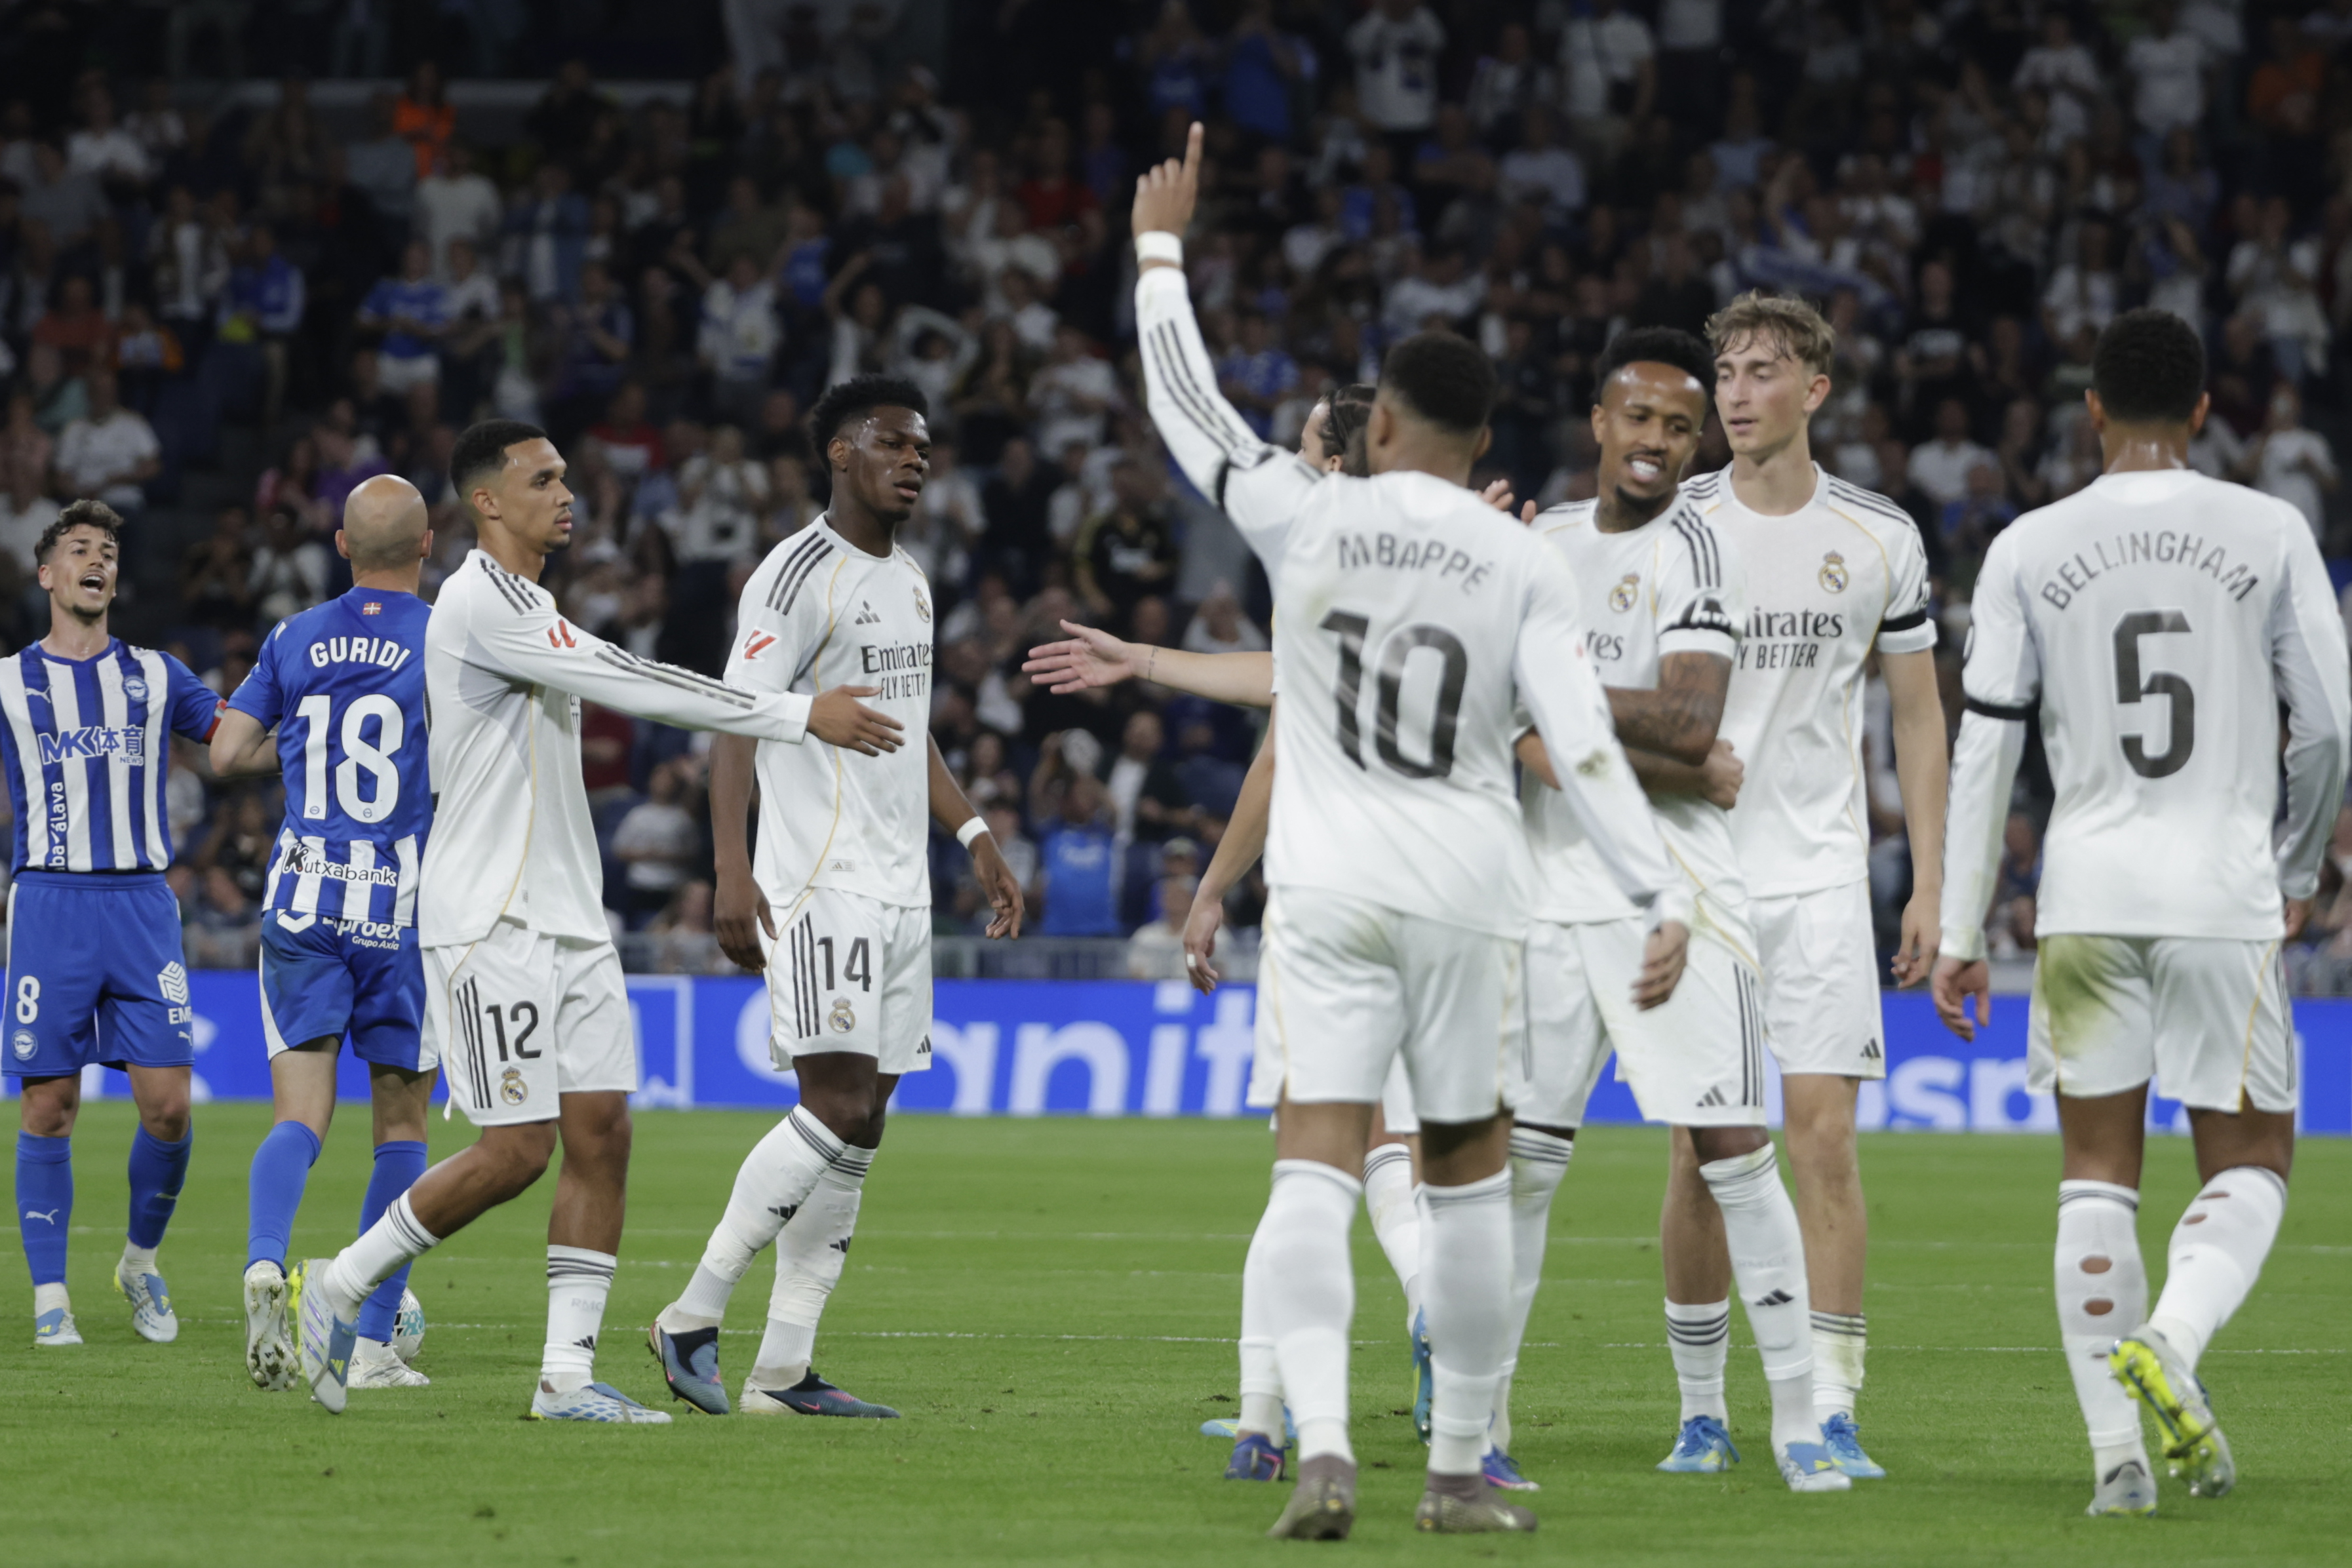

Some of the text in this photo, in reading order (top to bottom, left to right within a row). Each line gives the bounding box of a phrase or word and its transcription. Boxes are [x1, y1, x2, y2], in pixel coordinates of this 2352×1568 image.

[1337, 532, 1495, 596] MBAPPÉ
[2040, 530, 2259, 611] BELLINGHAM
[1744, 606, 1843, 638] irates
[309, 636, 411, 672] GURIDI
[1755, 643, 1818, 669] BETTER
[880, 675, 897, 701] FLY
[1318, 608, 1468, 779] 10
[2111, 608, 2196, 779] 5
[119, 755, 144, 766] NEWS
[296, 694, 404, 824] 18
[284, 844, 397, 886] Kutxabank
[323, 917, 402, 941] proex
[352, 935, 400, 950] Grupo Axia
[817, 936, 872, 992] 14
[16, 975, 40, 1024] 8
[484, 1000, 542, 1062] 12
